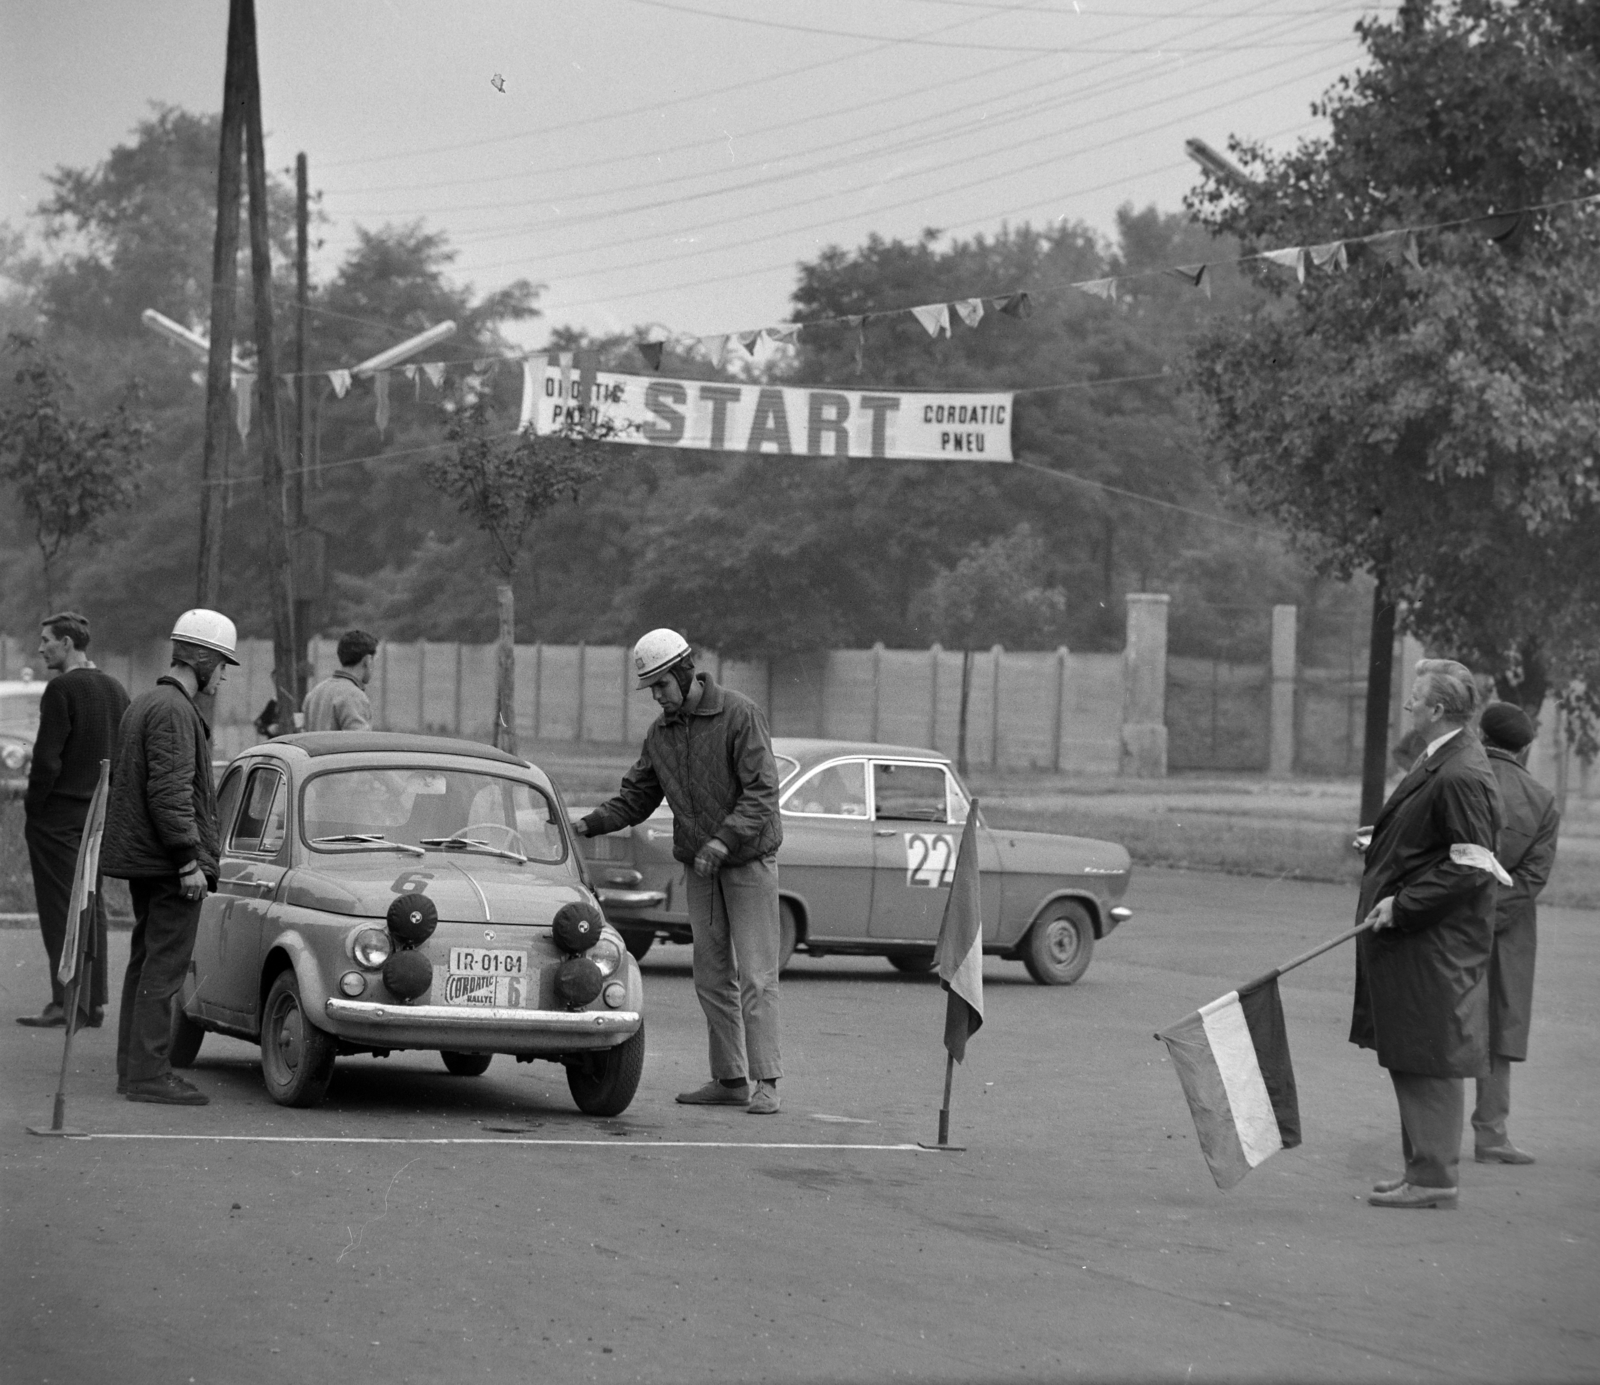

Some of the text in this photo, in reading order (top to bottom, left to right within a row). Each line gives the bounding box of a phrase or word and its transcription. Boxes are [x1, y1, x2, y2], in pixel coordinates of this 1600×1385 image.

[643, 381, 901, 458] START
[923, 404, 1006, 425] CORDATIC
[941, 431, 985, 452] PNEU
[909, 834, 954, 887] 22
[390, 871, 434, 896] 6
[449, 976, 494, 1002] CORDATIC
[466, 994, 494, 1004] RALLYE
[507, 976, 521, 1007] 6
